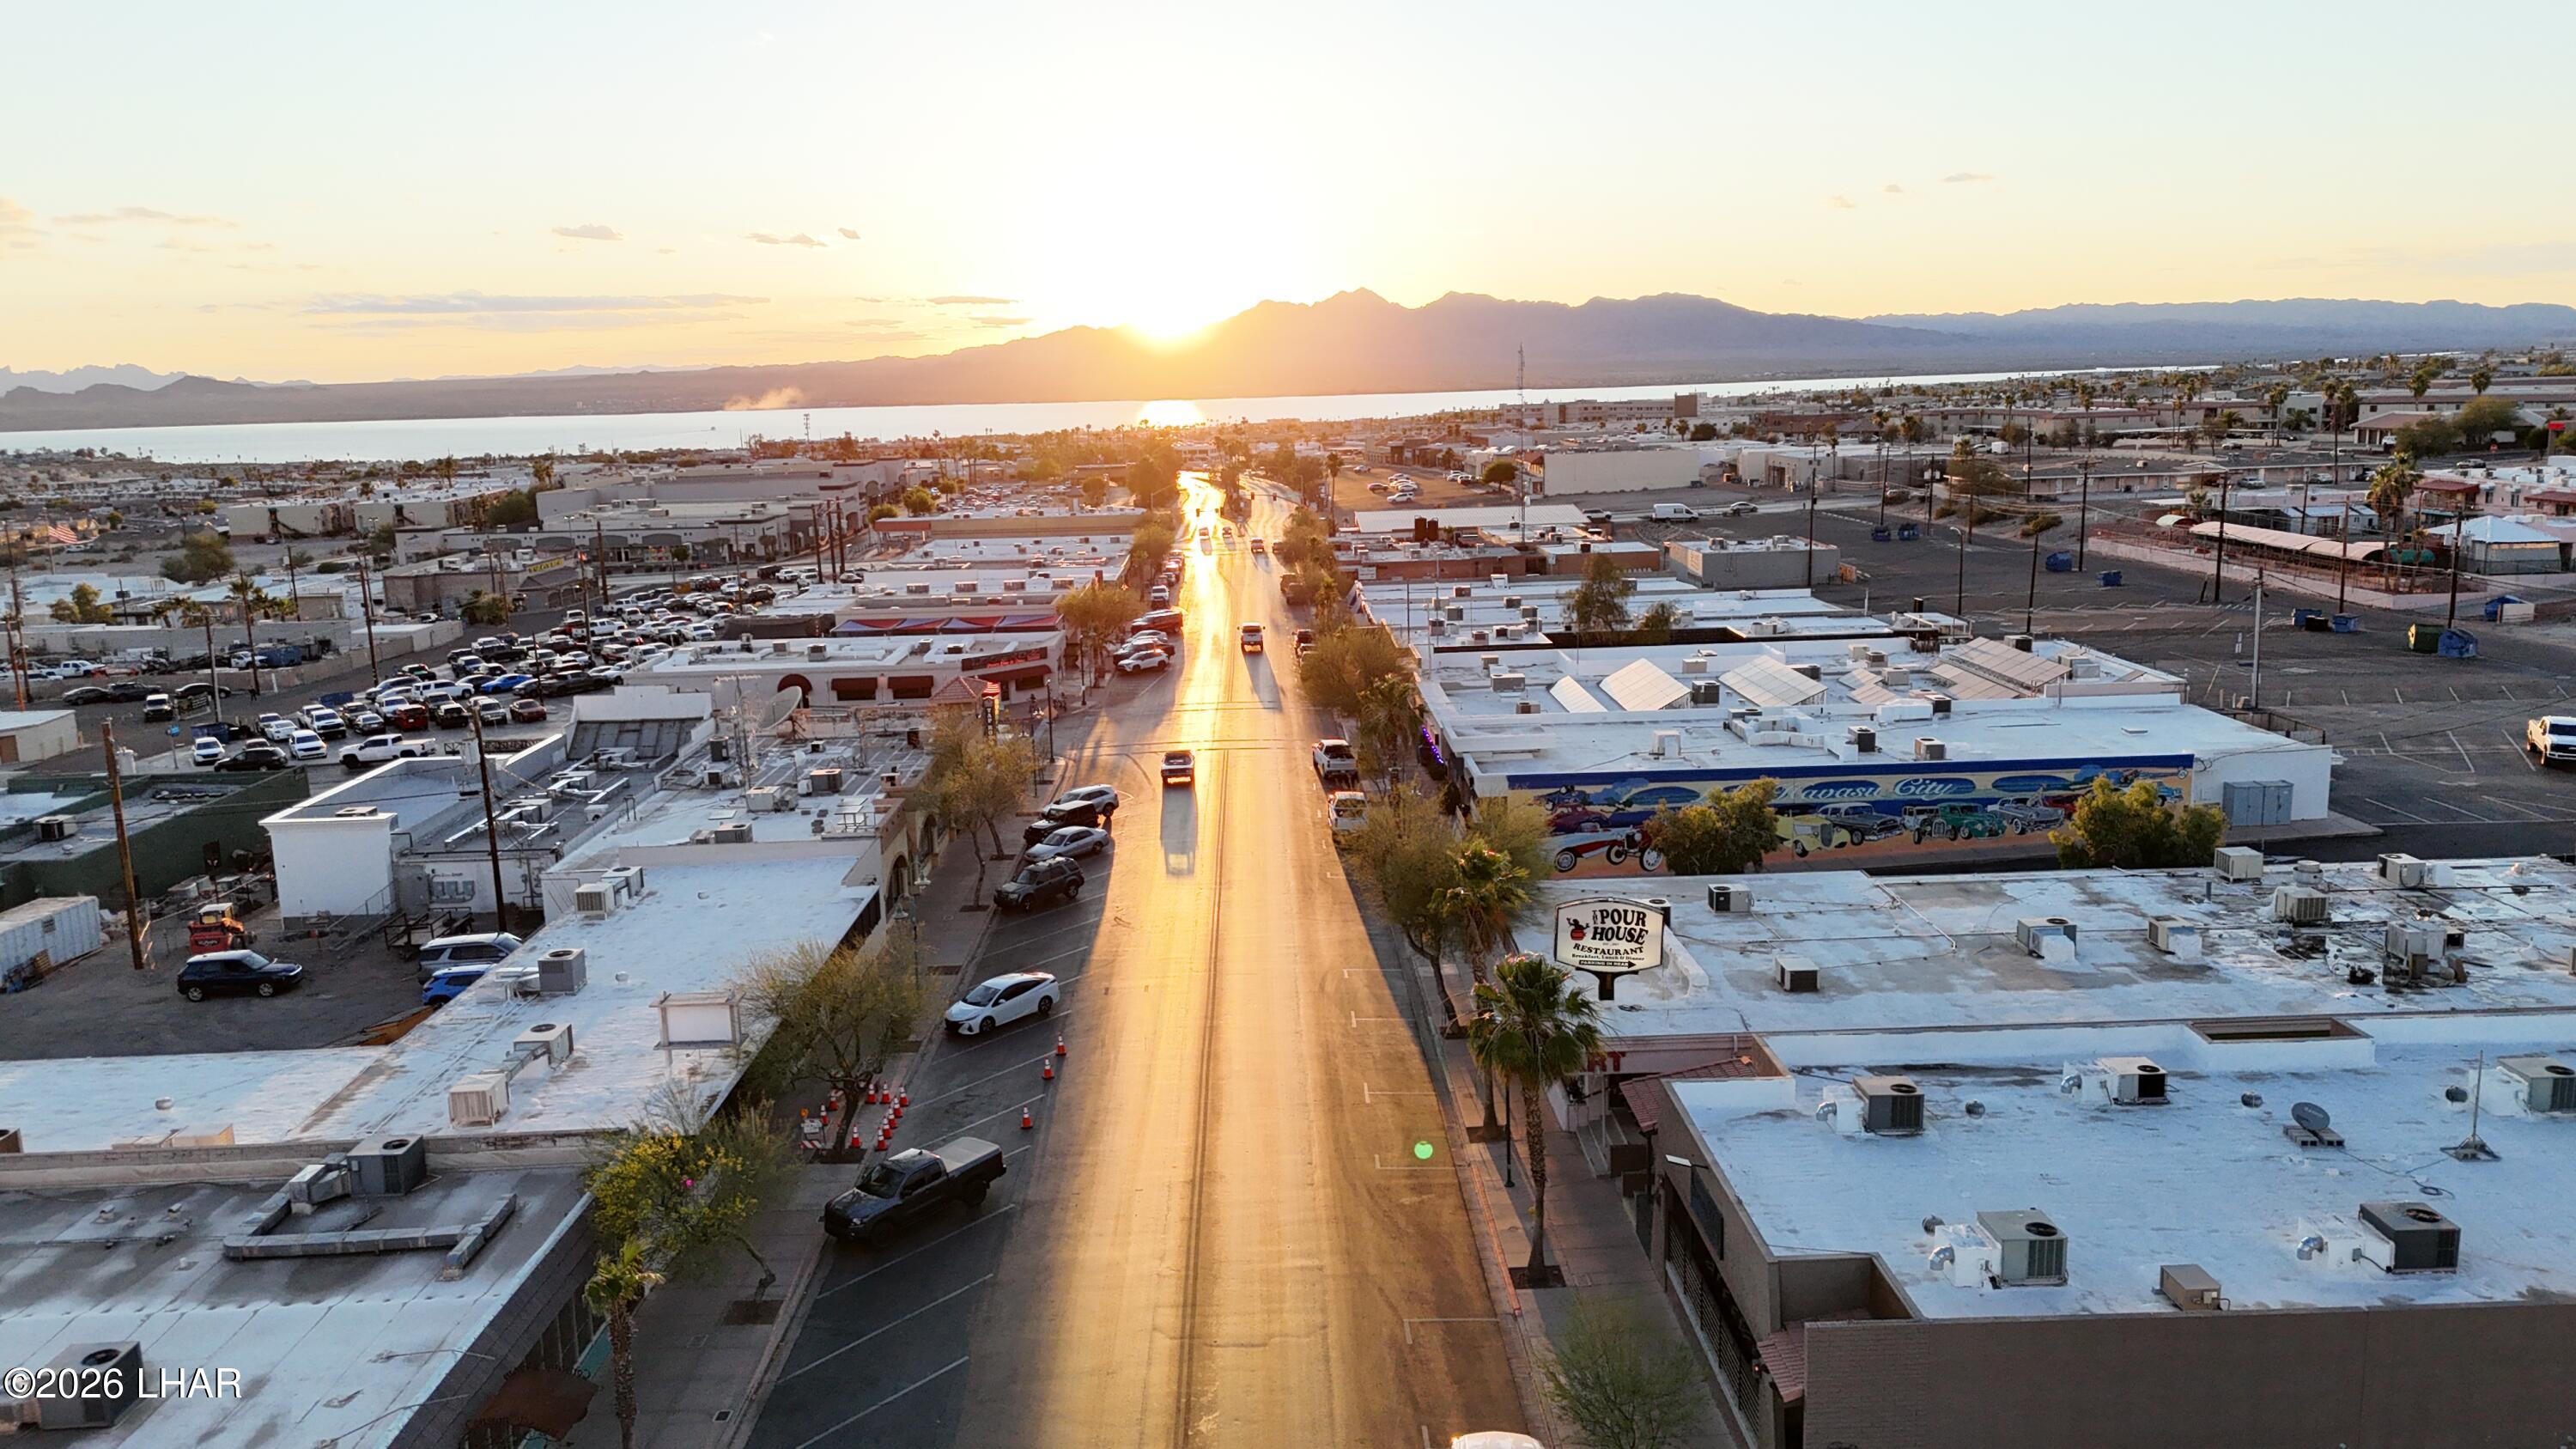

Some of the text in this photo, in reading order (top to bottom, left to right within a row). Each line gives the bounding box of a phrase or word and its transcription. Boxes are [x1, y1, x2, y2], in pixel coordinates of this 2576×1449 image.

[1895, 777, 1953, 801] City
[1599, 909, 1647, 927] POUR
[1591, 925, 1649, 946] HOUSE
[1573, 943, 1644, 955] RESTAURANT
